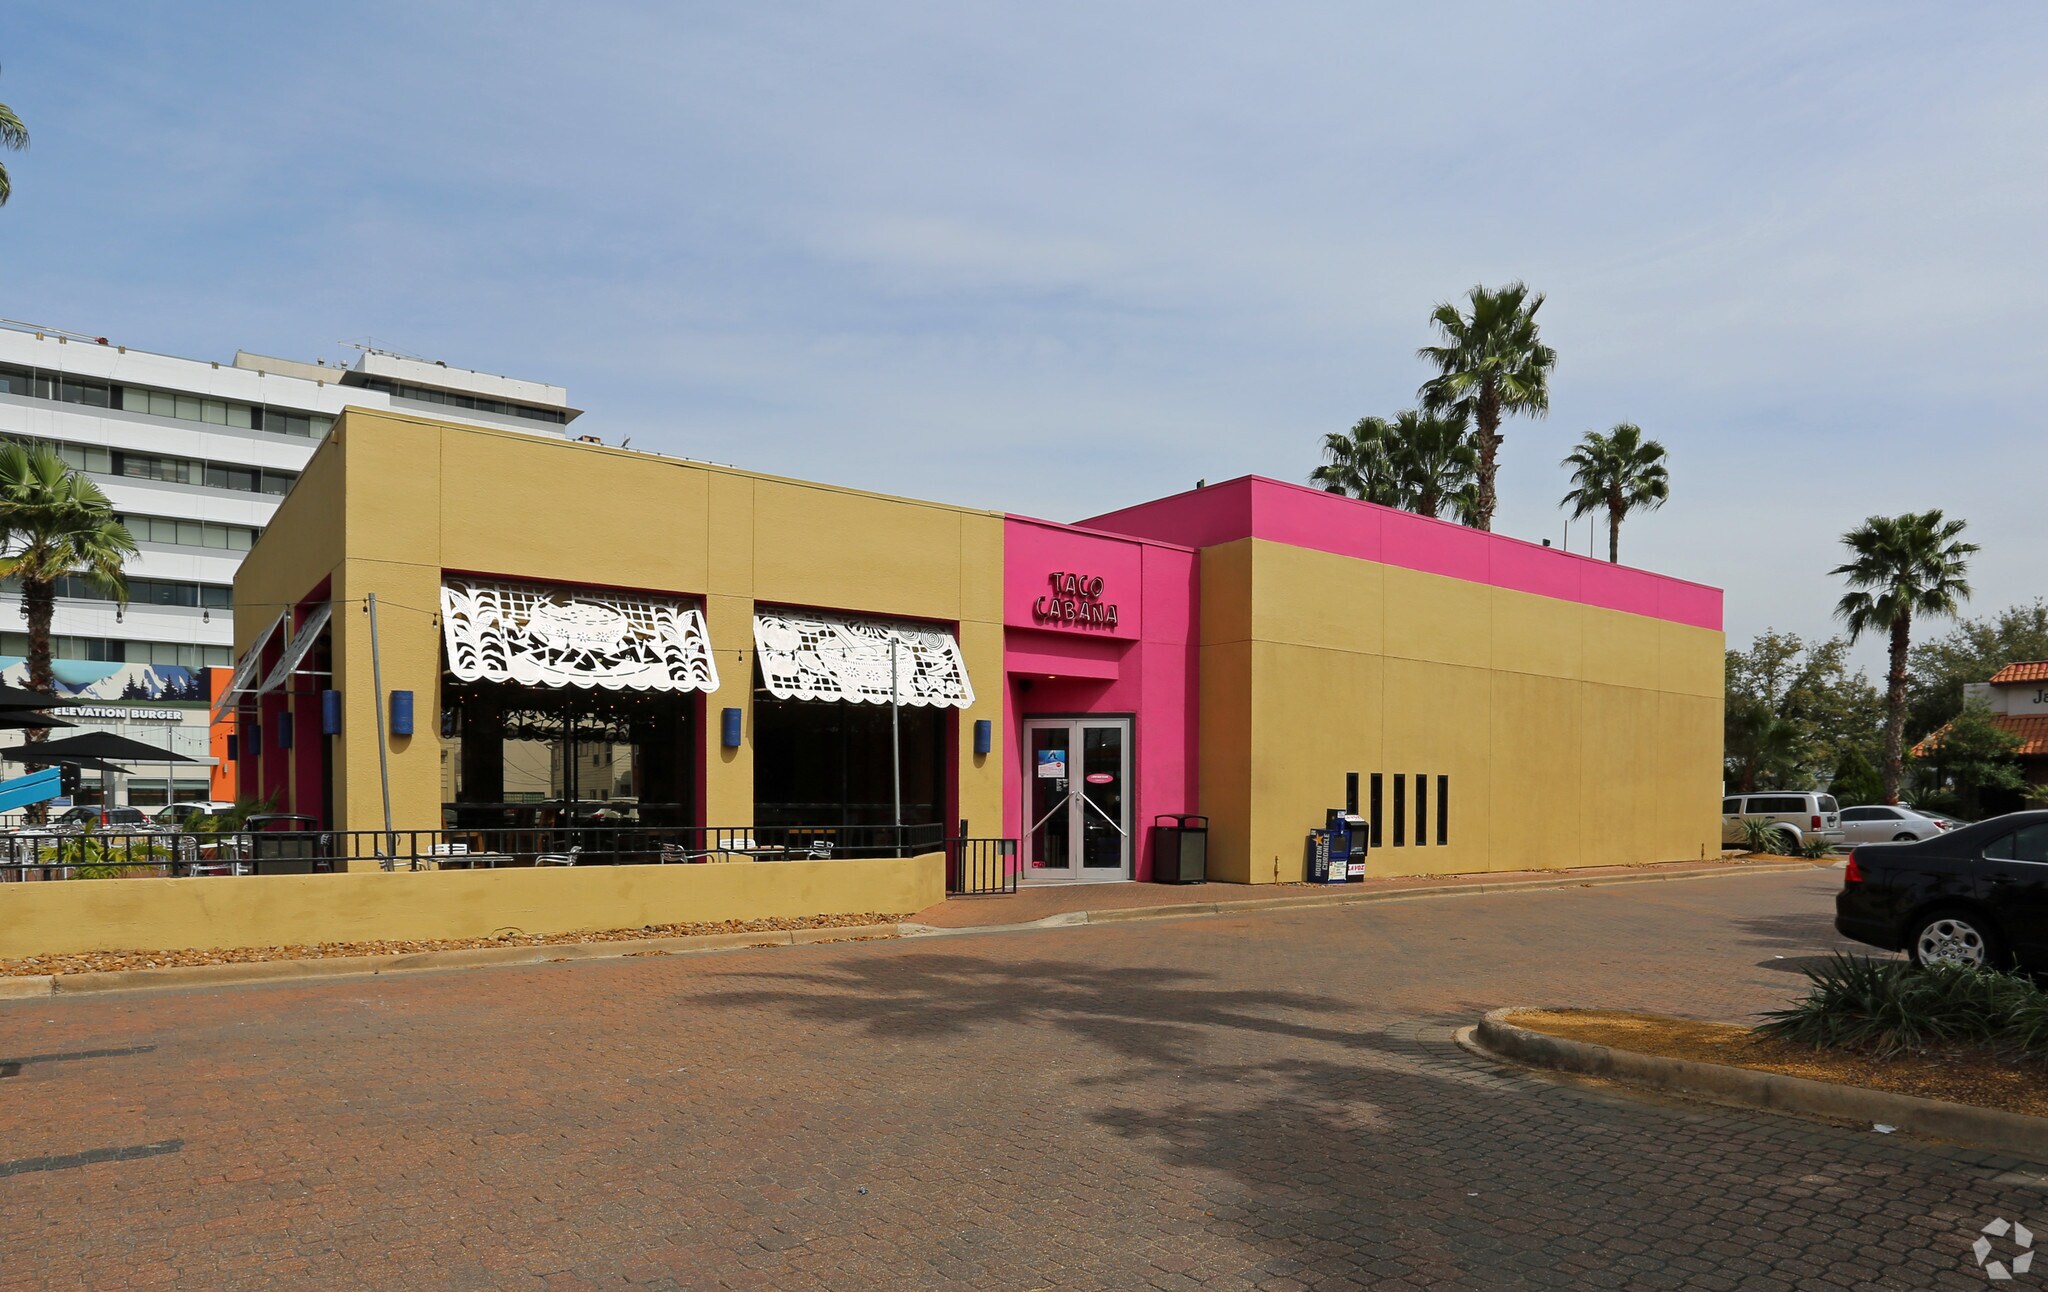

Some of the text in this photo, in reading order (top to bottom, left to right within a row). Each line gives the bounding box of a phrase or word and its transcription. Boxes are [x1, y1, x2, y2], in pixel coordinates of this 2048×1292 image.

[1049, 572, 1104, 598] TACO
[1034, 596, 1118, 626] CABANA
[53, 707, 182, 720] ELEVATION BURGER
[1322, 833, 1330, 870] CHRONICLE
